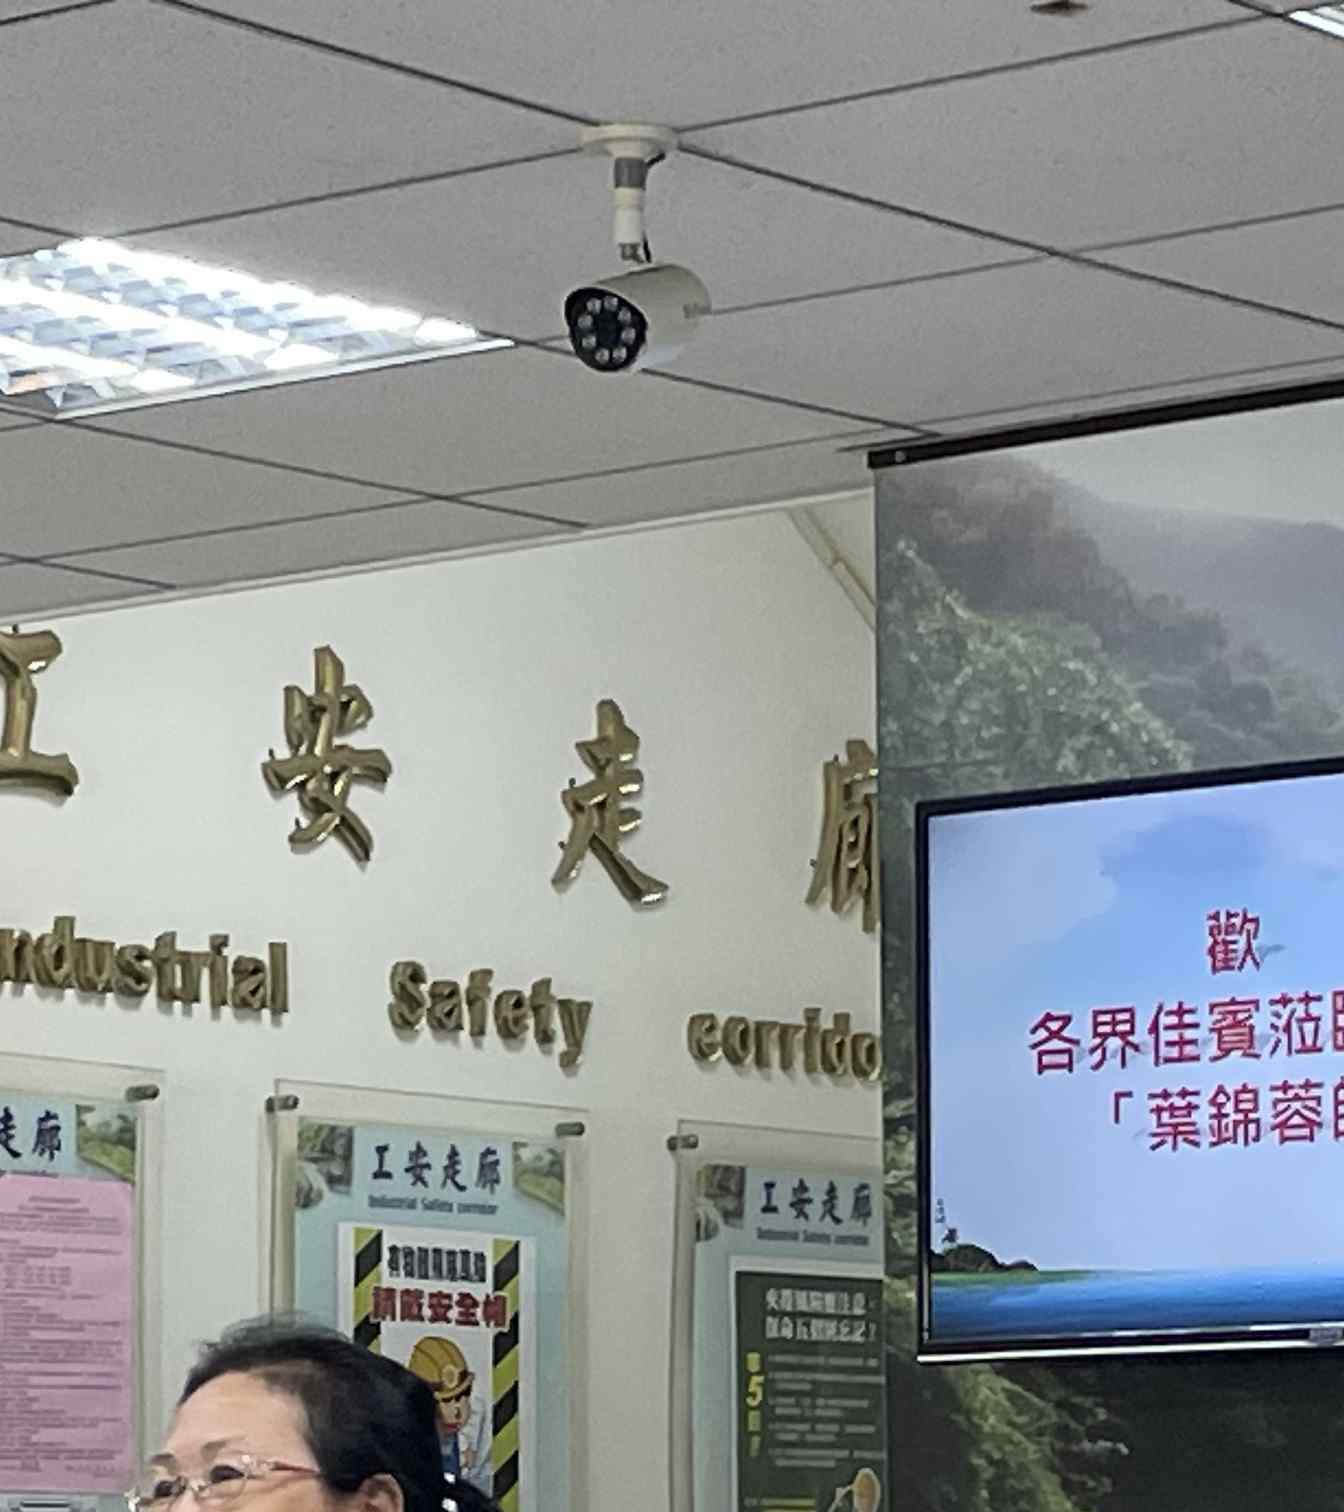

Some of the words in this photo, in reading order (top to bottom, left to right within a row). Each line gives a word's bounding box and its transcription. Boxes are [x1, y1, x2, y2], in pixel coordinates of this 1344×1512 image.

[1206, 908, 1262, 975] 歡
[390, 958, 592, 1070] Safety
[371, 1140, 502, 1195] 工安走廊
[760, 1177, 873, 1227] 工安走廊
